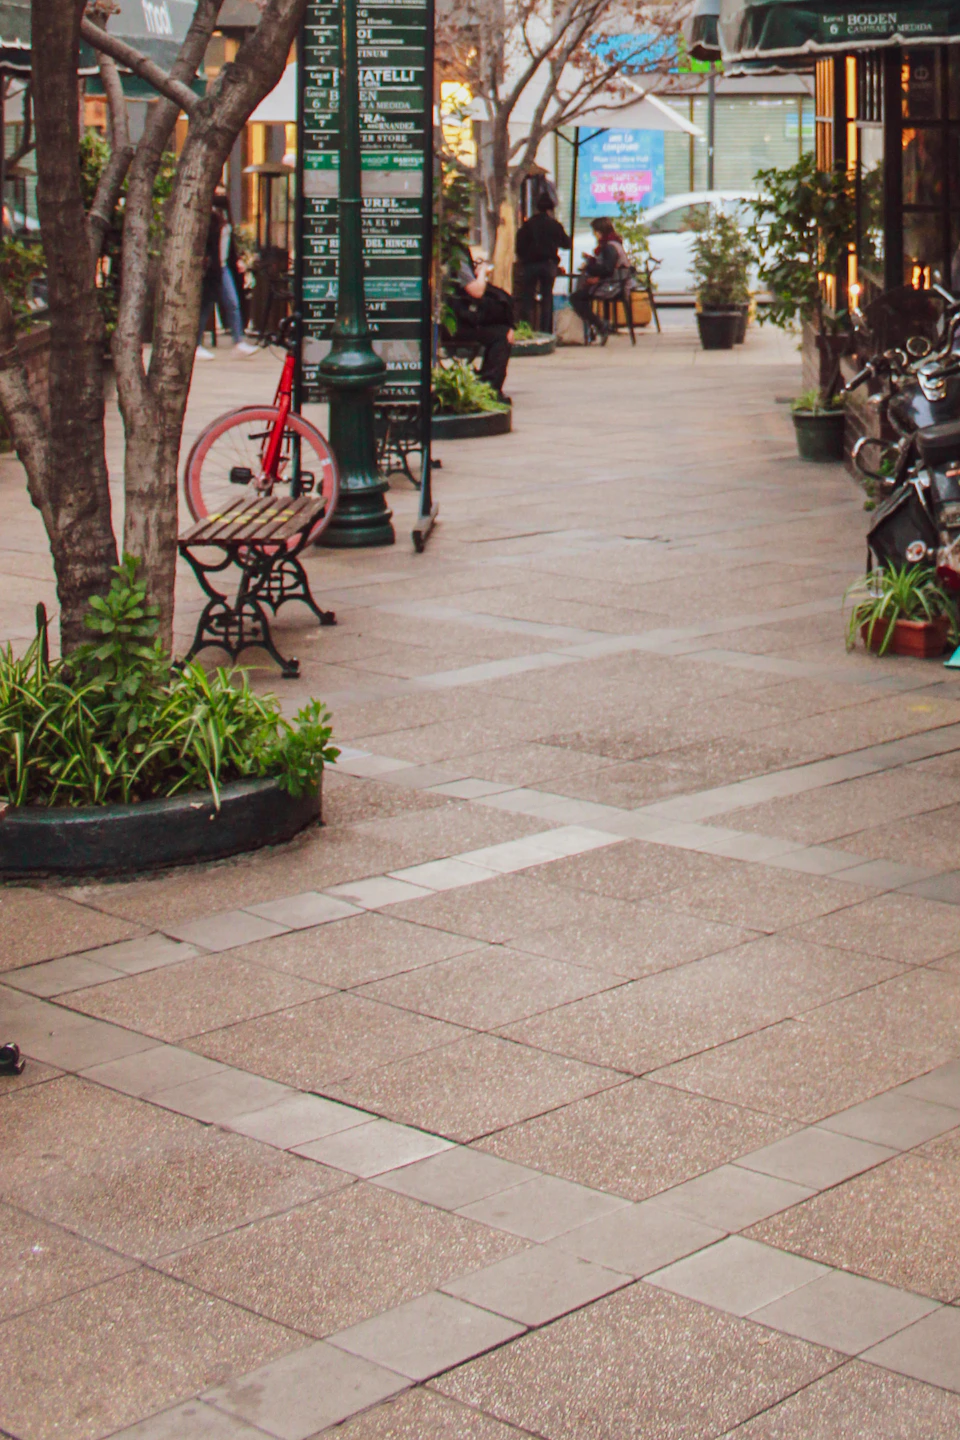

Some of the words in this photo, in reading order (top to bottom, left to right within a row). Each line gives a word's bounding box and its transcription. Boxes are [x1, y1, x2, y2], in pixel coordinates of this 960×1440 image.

[847, 12, 898, 26] BODEN
[830, 24, 839, 35] 6
[312, 99, 321, 109] 6
[365, 239, 384, 248] DEL
[385, 239, 419, 248] HINCHA
[305, 372, 316, 380] 19
